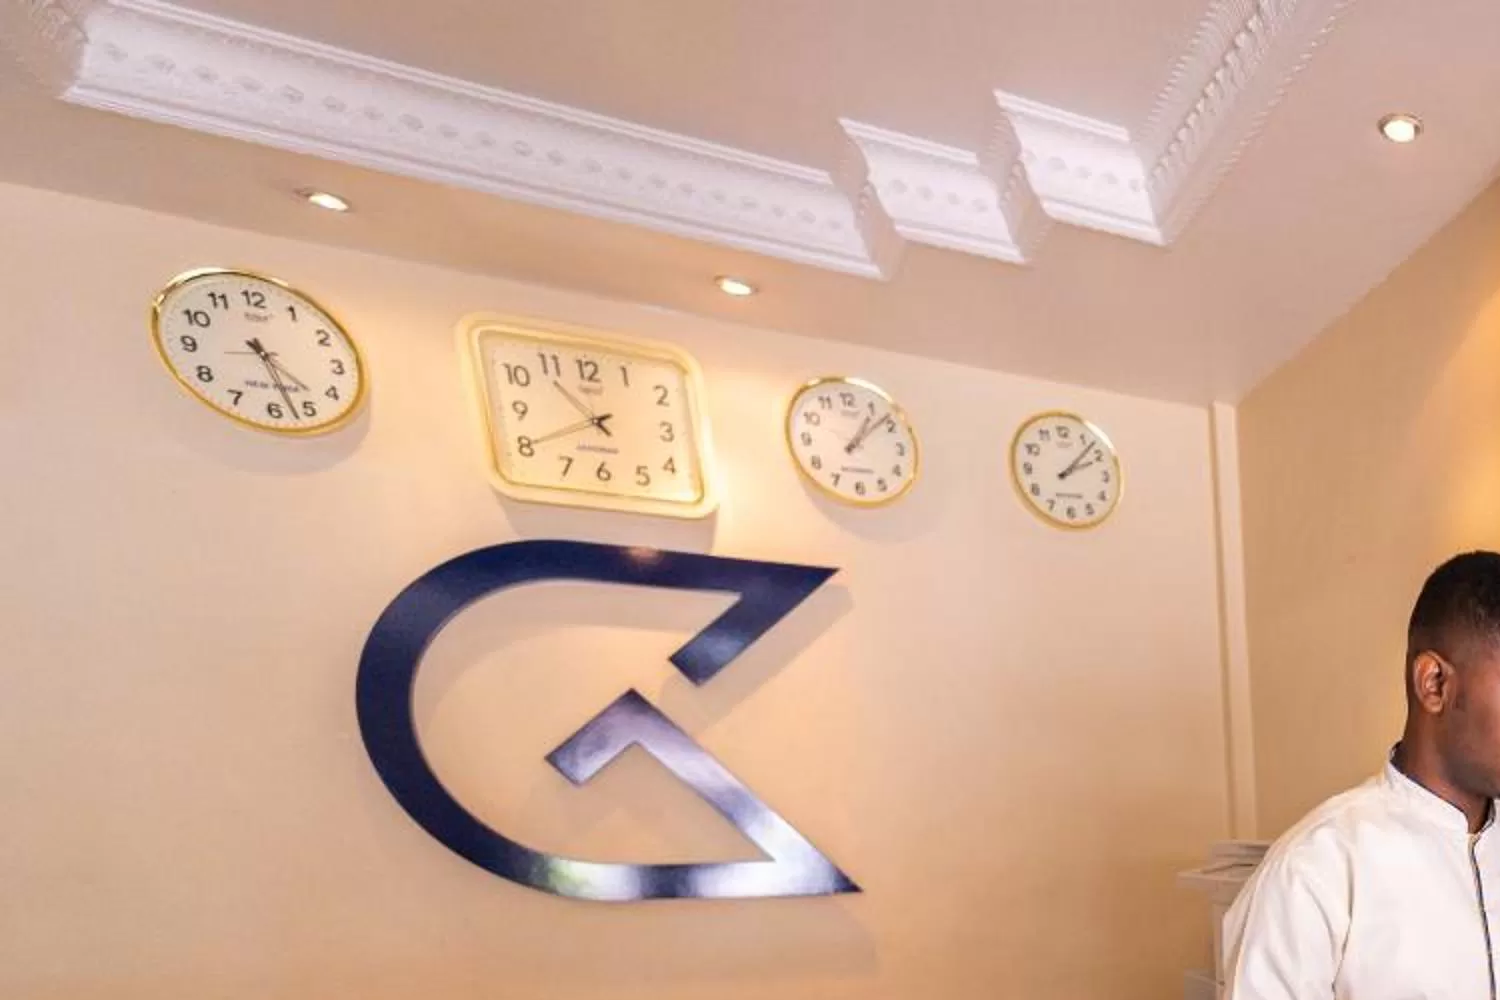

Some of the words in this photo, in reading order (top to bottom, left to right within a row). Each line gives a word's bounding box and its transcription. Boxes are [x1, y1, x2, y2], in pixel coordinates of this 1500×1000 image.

[208, 292, 229, 310] 11
[240, 290, 266, 308] 12
[184, 309, 211, 328] 10
[286, 305, 297, 322] 1
[180, 335, 198, 352] 9
[316, 329, 331, 346] 2
[196, 365, 214, 382] 8
[331, 359, 345, 375] 3
[538, 352, 561, 377] 11
[576, 358, 600, 382] 12
[502, 362, 530, 387] 10
[620, 365, 630, 388] 1
[227, 388, 244, 406] 7
[325, 386, 339, 401] 4
[653, 384, 670, 407] 2
[268, 403, 284, 419] 6
[302, 401, 317, 417] 5
[512, 400, 528, 420] 9
[660, 421, 675, 443] 3
[517, 436, 534, 458] 8
[558, 456, 574, 478] 7
[596, 462, 612, 482] 6
[663, 456, 677, 475] 4
[636, 466, 650, 486] 5
